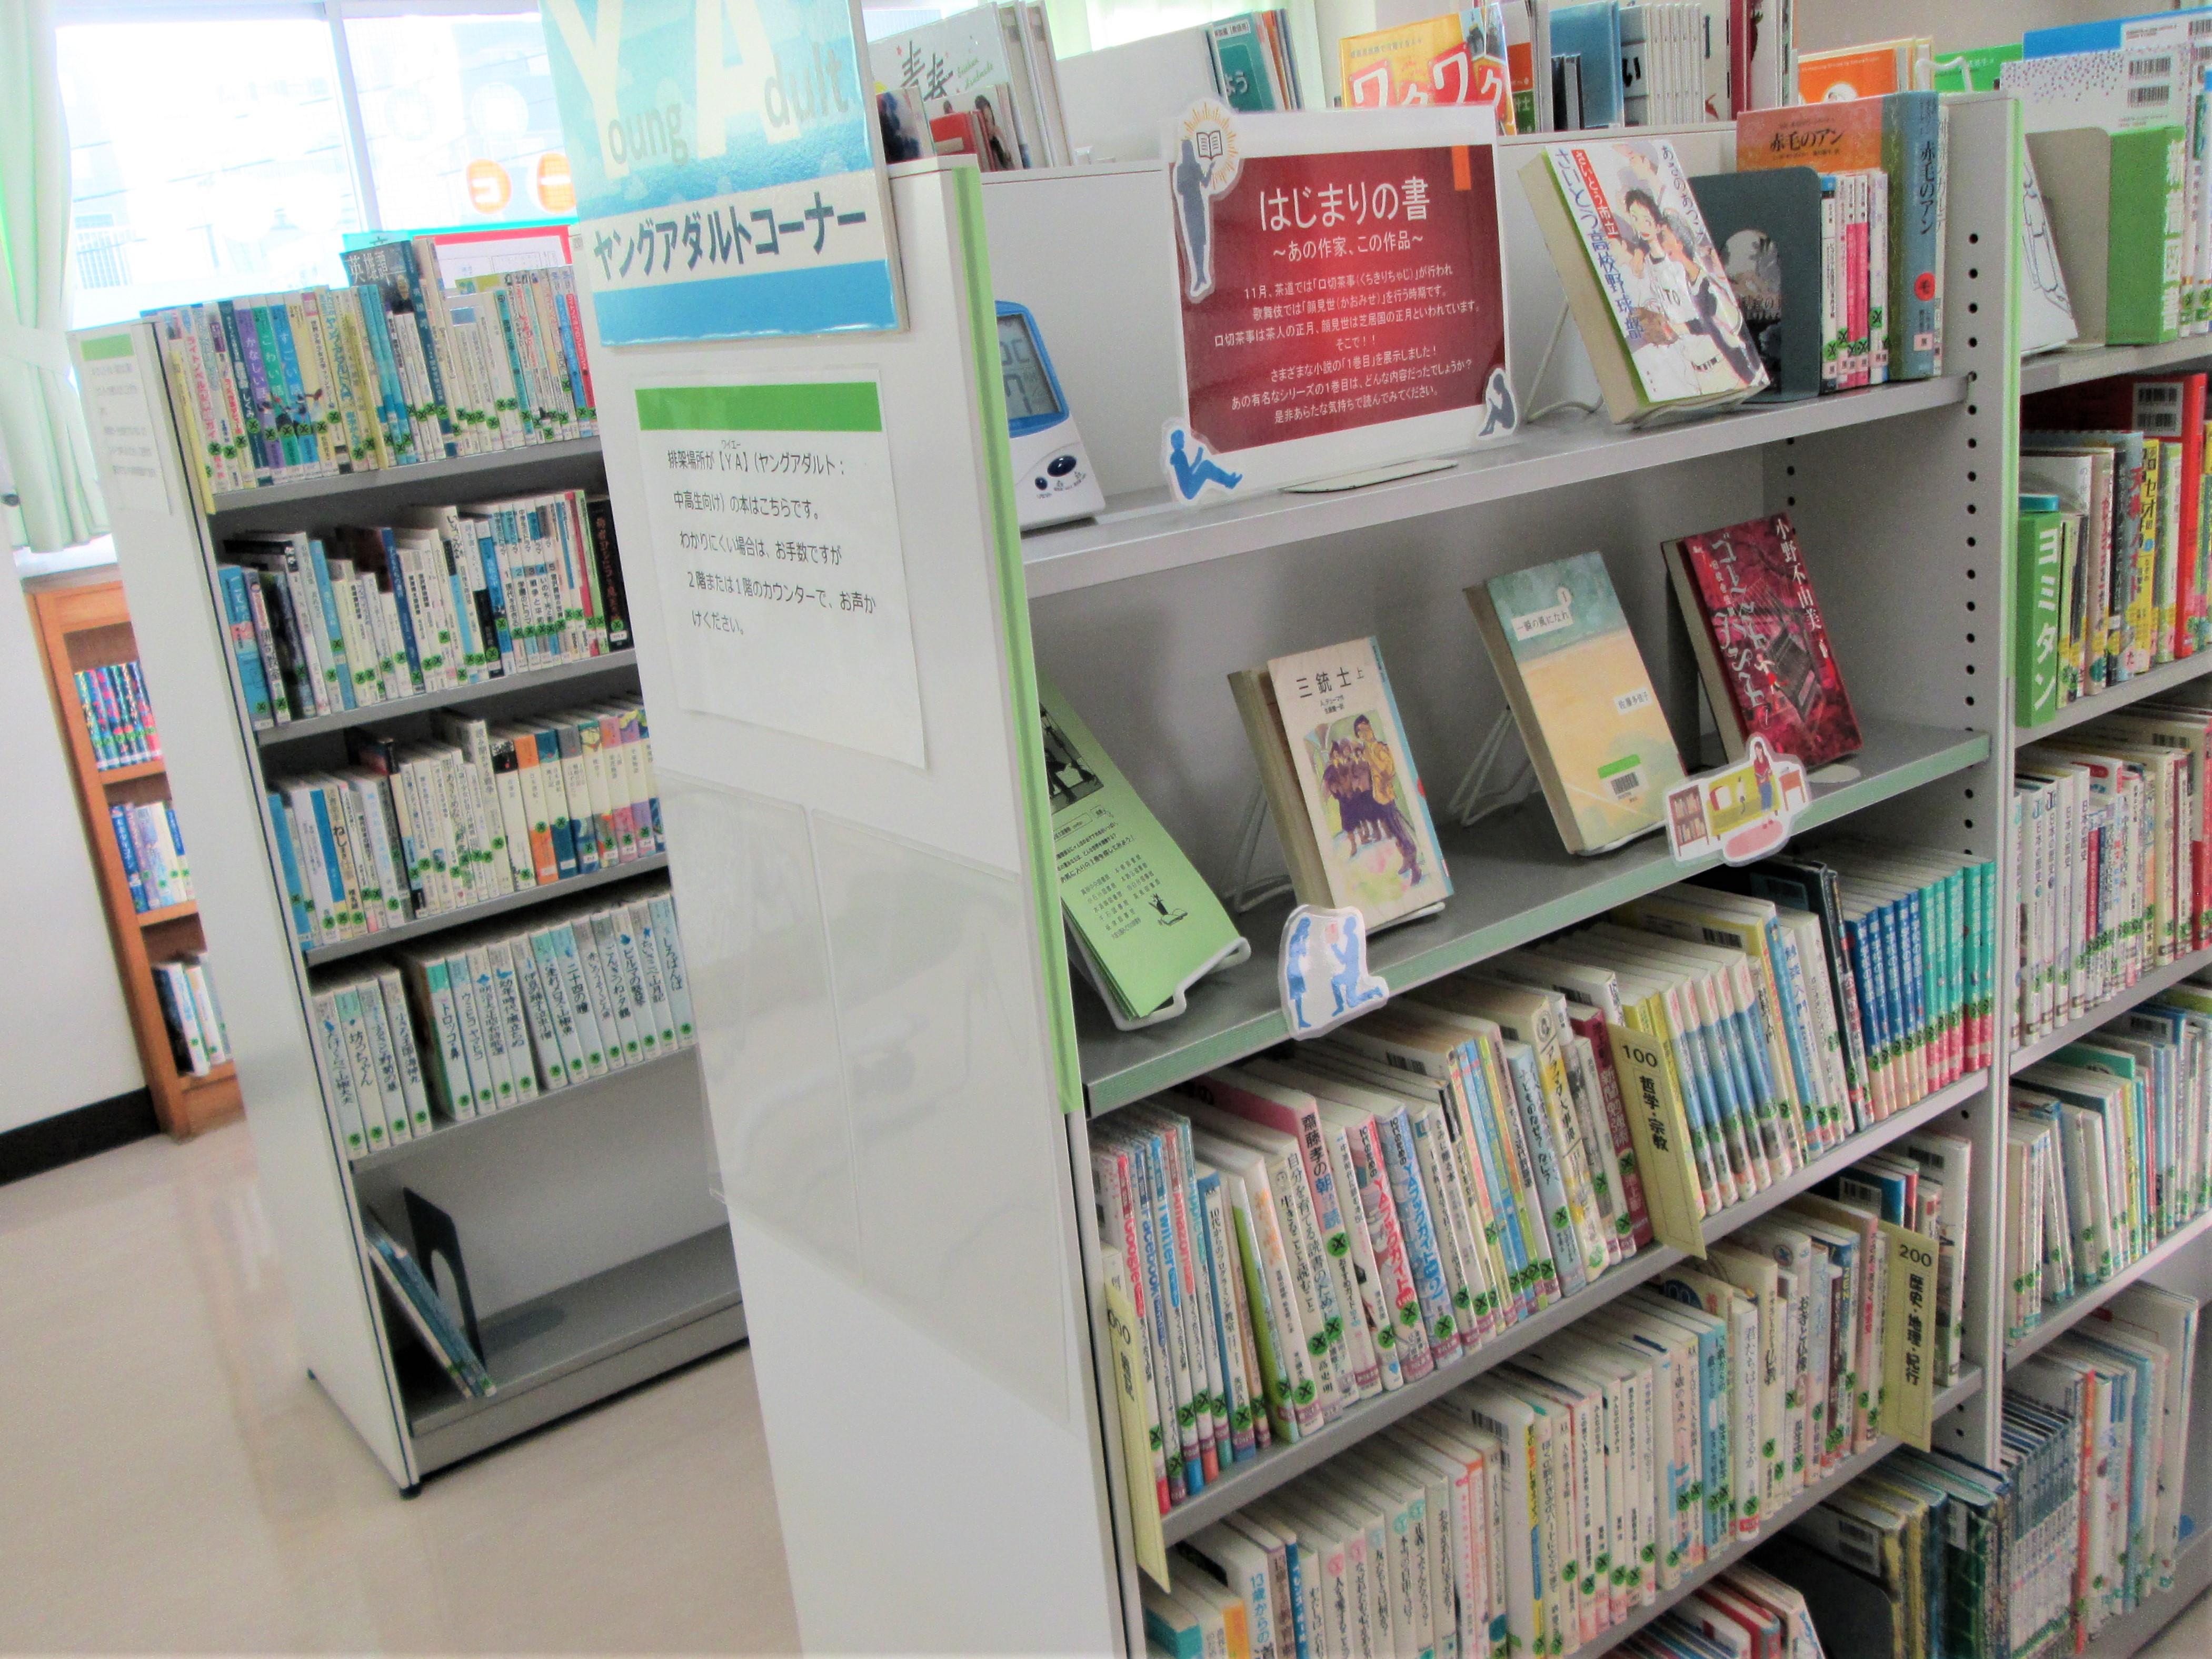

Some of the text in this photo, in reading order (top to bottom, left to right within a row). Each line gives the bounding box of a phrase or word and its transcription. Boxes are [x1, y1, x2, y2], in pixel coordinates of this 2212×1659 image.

[1770, 127, 1844, 152] 赤毛のアン
[1259, 176, 1430, 232] はじまりの書
[1920, 141, 1936, 235] 赤毛のアン
[594, 192, 867, 281] ヤングアダルトコーナー
[1555, 148, 1645, 340] さいとう高校野球部
[680, 531, 842, 565] わかりにくい場合は、お手数ですが
[1776, 518, 1822, 631] 小野不由美
[692, 611, 744, 635] けください。
[1297, 667, 1365, 698] 三銃士 上
[1621, 1045, 1658, 1068] 100
[1899, 1245, 1932, 1267] 200
